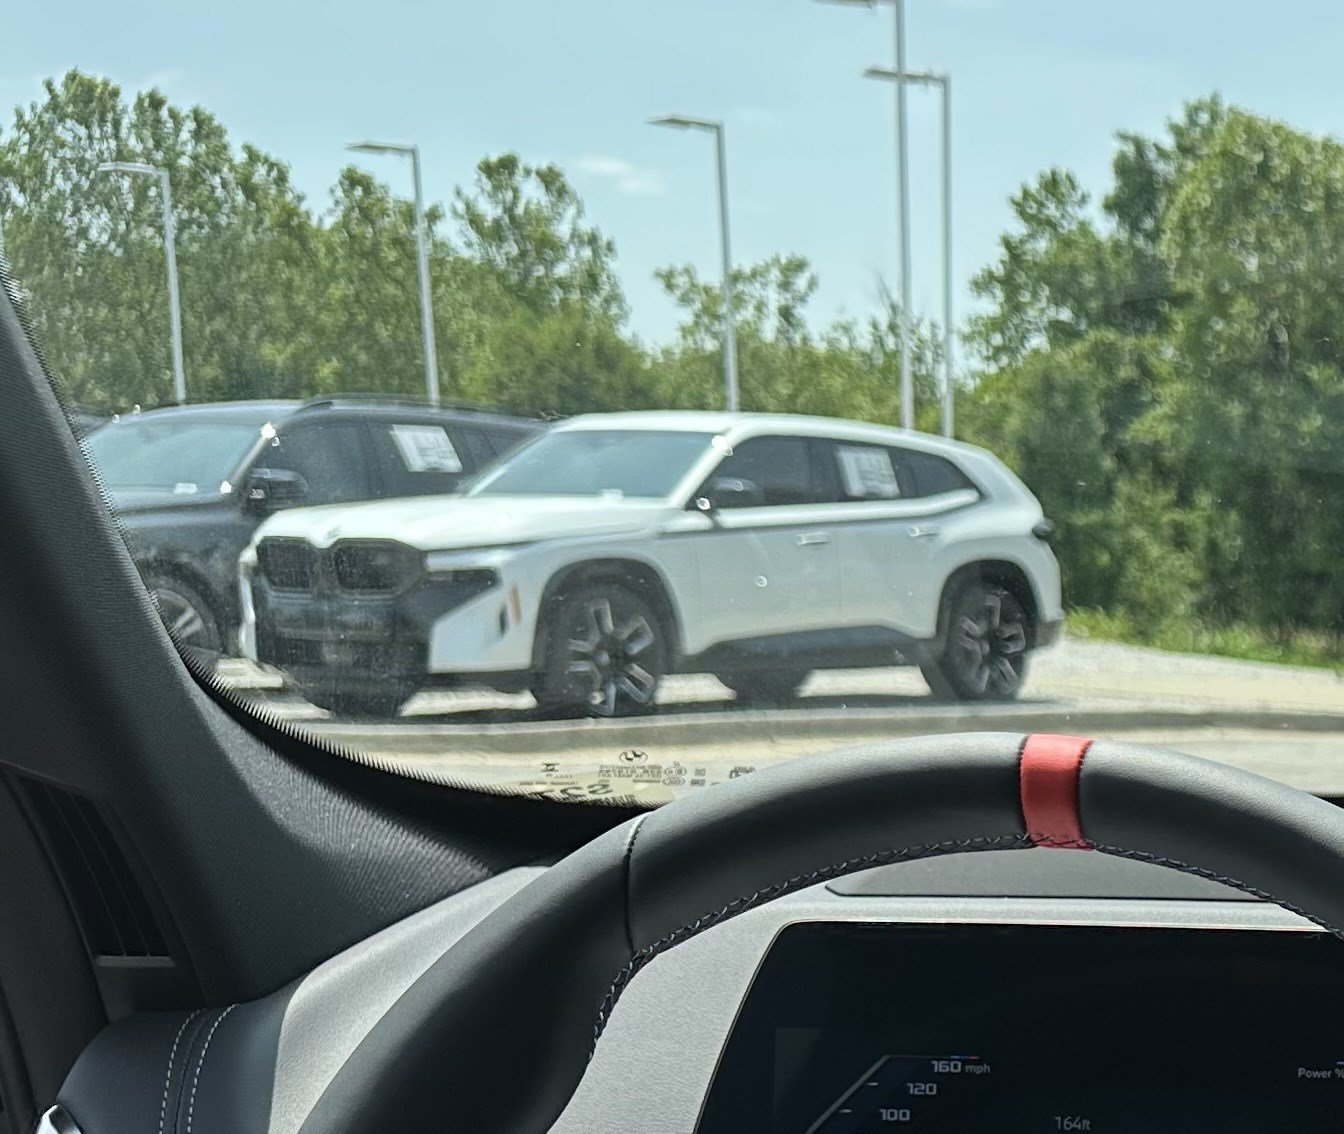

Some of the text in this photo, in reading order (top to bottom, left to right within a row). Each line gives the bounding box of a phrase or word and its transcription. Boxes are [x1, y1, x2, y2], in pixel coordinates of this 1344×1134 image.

[931, 1060, 991, 1075] 160 mph
[1297, 1067, 1332, 1079] Power
[907, 1083, 937, 1096] 120
[879, 1108, 911, 1121] 100
[1054, 1115, 1092, 1132] 164ft
